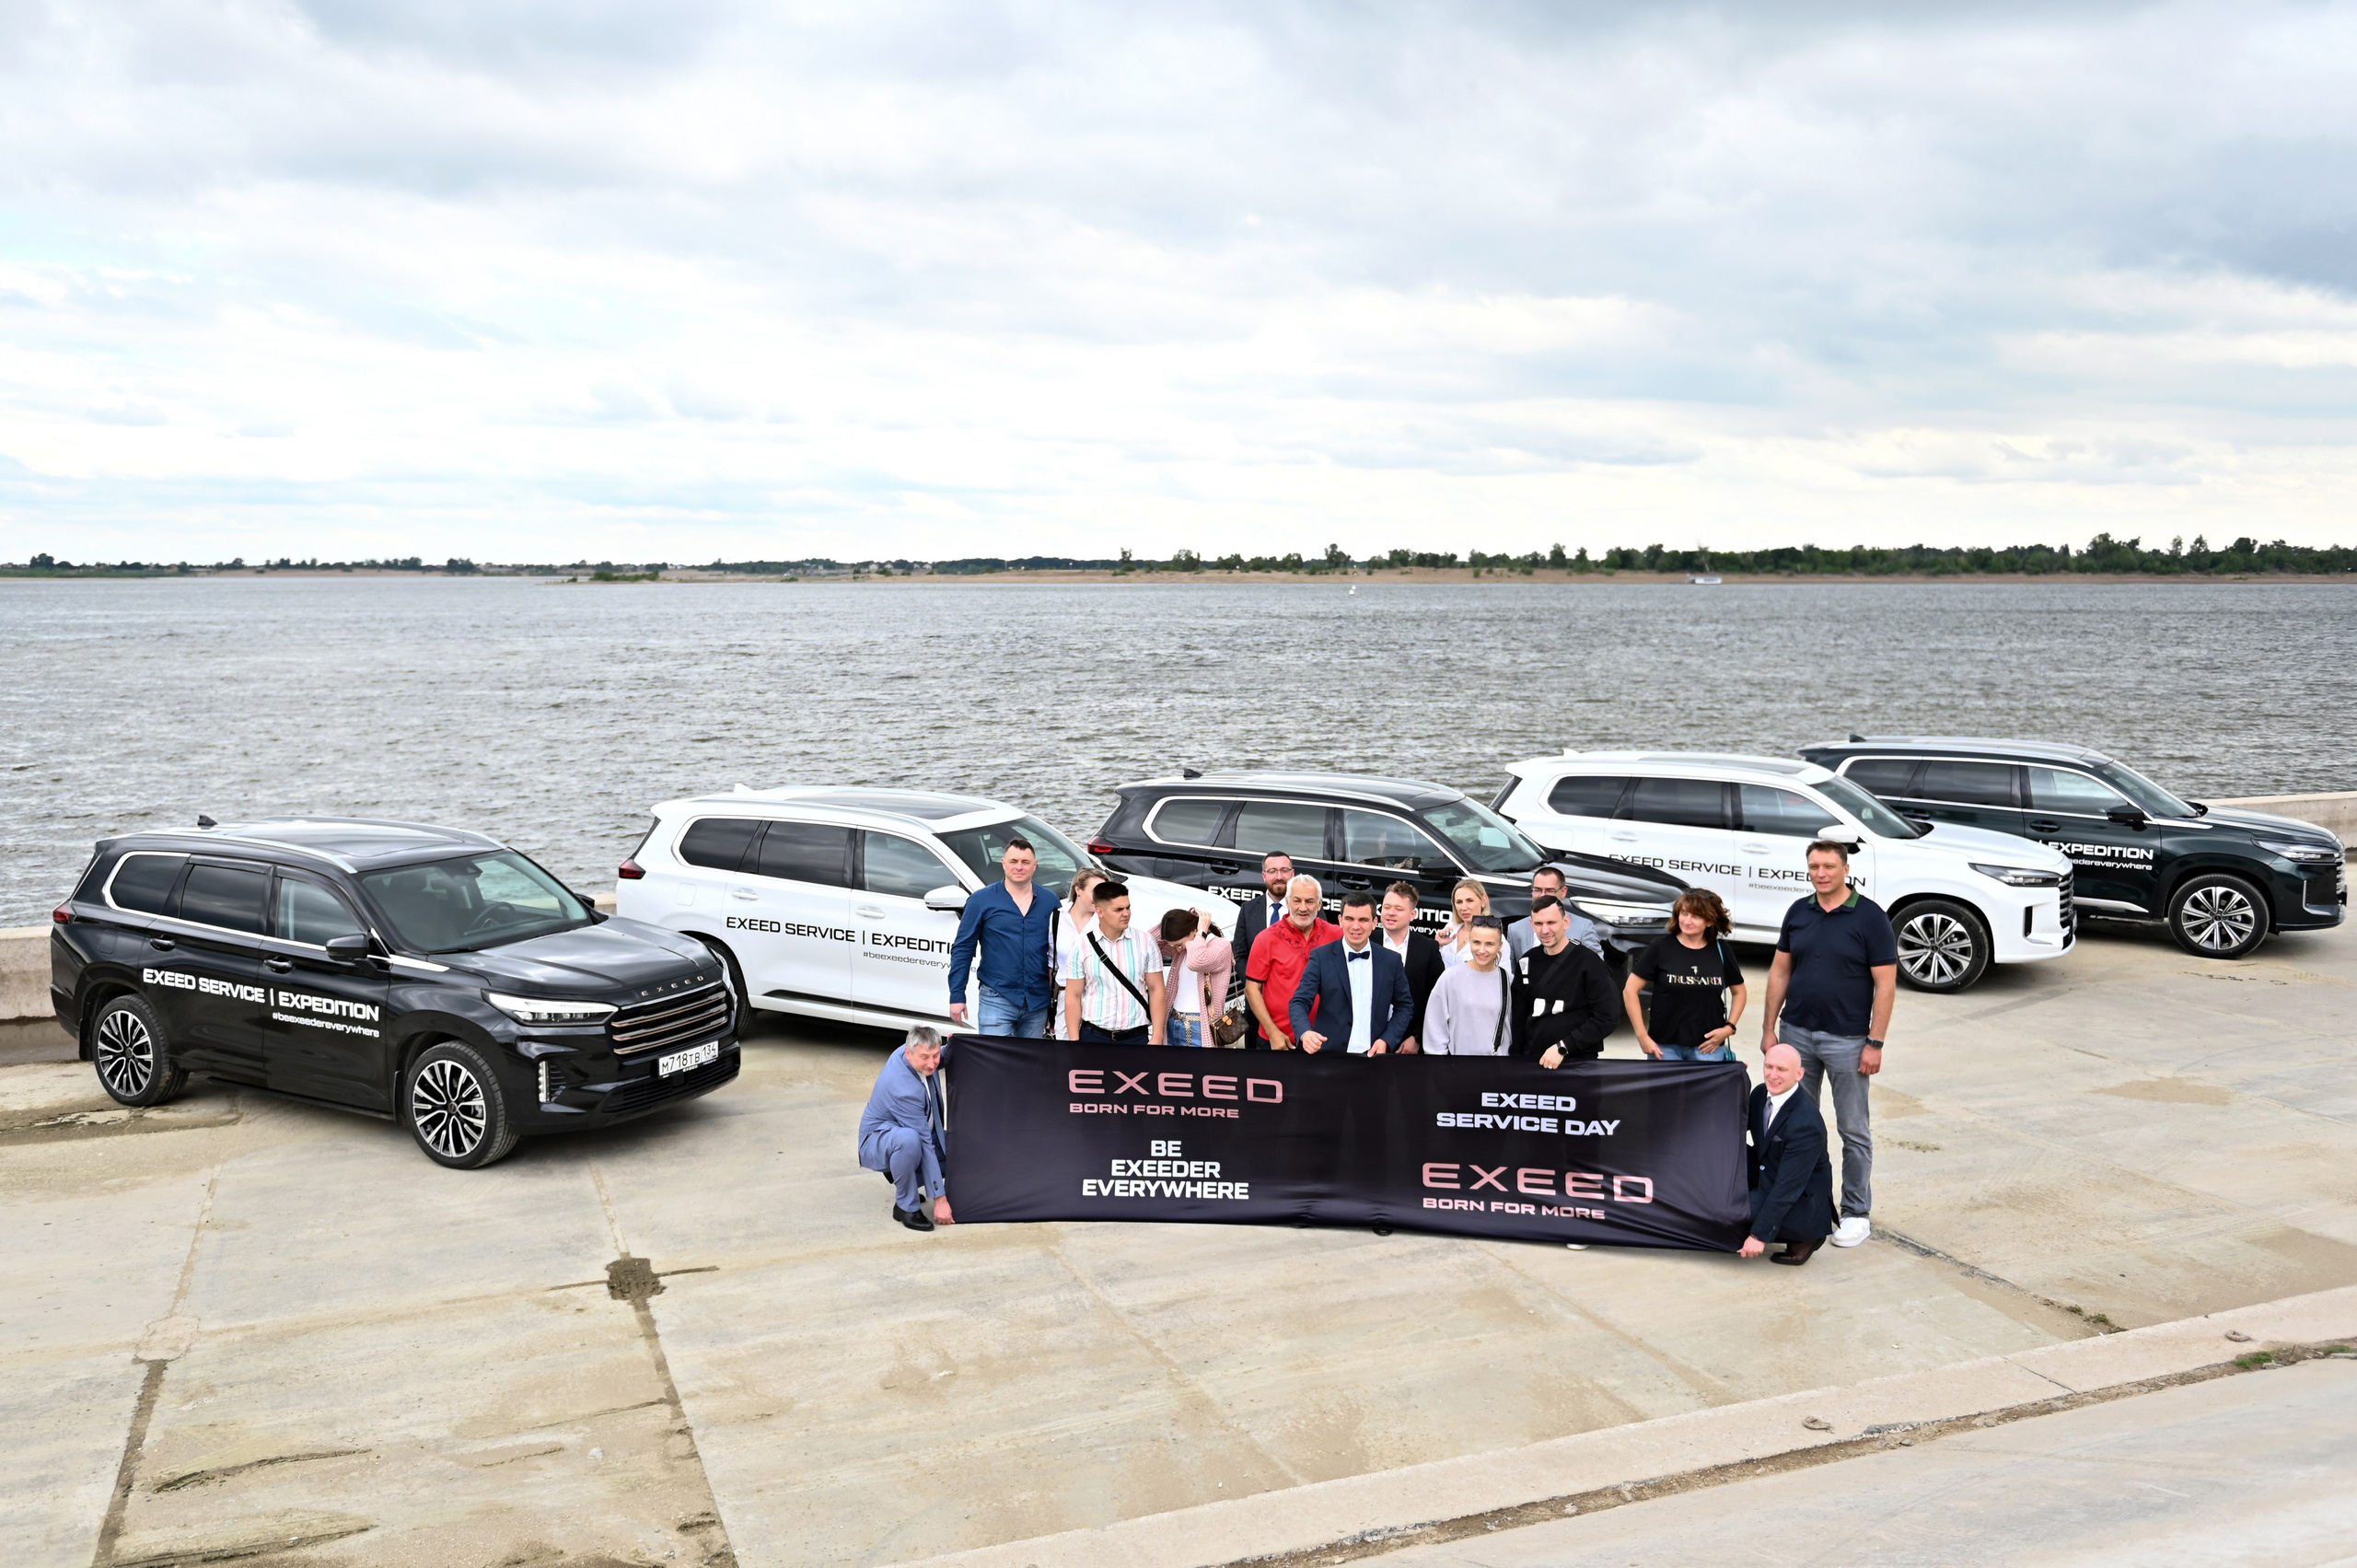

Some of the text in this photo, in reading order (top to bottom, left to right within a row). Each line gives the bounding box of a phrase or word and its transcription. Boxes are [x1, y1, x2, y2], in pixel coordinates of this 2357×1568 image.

[1668, 859, 1742, 877] SERVICE
[726, 916, 782, 934] EXEED
[784, 923, 855, 943] SERVICE
[871, 933, 955, 955] EXPEDITI
[641, 975, 704, 997] EXEED
[1666, 973, 1723, 986] TRUSSARDI
[143, 968, 196, 991] EXEED
[198, 977, 266, 1004] SERVICE
[278, 990, 380, 1022] EXPEDITION
[272, 1011, 380, 1039] #beexeedereverywhere
[1068, 1069, 1284, 1104] EXEED
[1069, 1103, 1240, 1120] BORN FOR MORE
[1480, 1091, 1577, 1113] EXEED
[1436, 1112, 1621, 1137] SERVICE DAY
[1150, 1139, 1182, 1157] BE
[1110, 1158, 1221, 1179] EXEEDER
[1082, 1179, 1250, 1201] EVERYWHERE
[1422, 1162, 1655, 1205] EXEED
[1422, 1197, 1607, 1220] BORN FOR MORE
